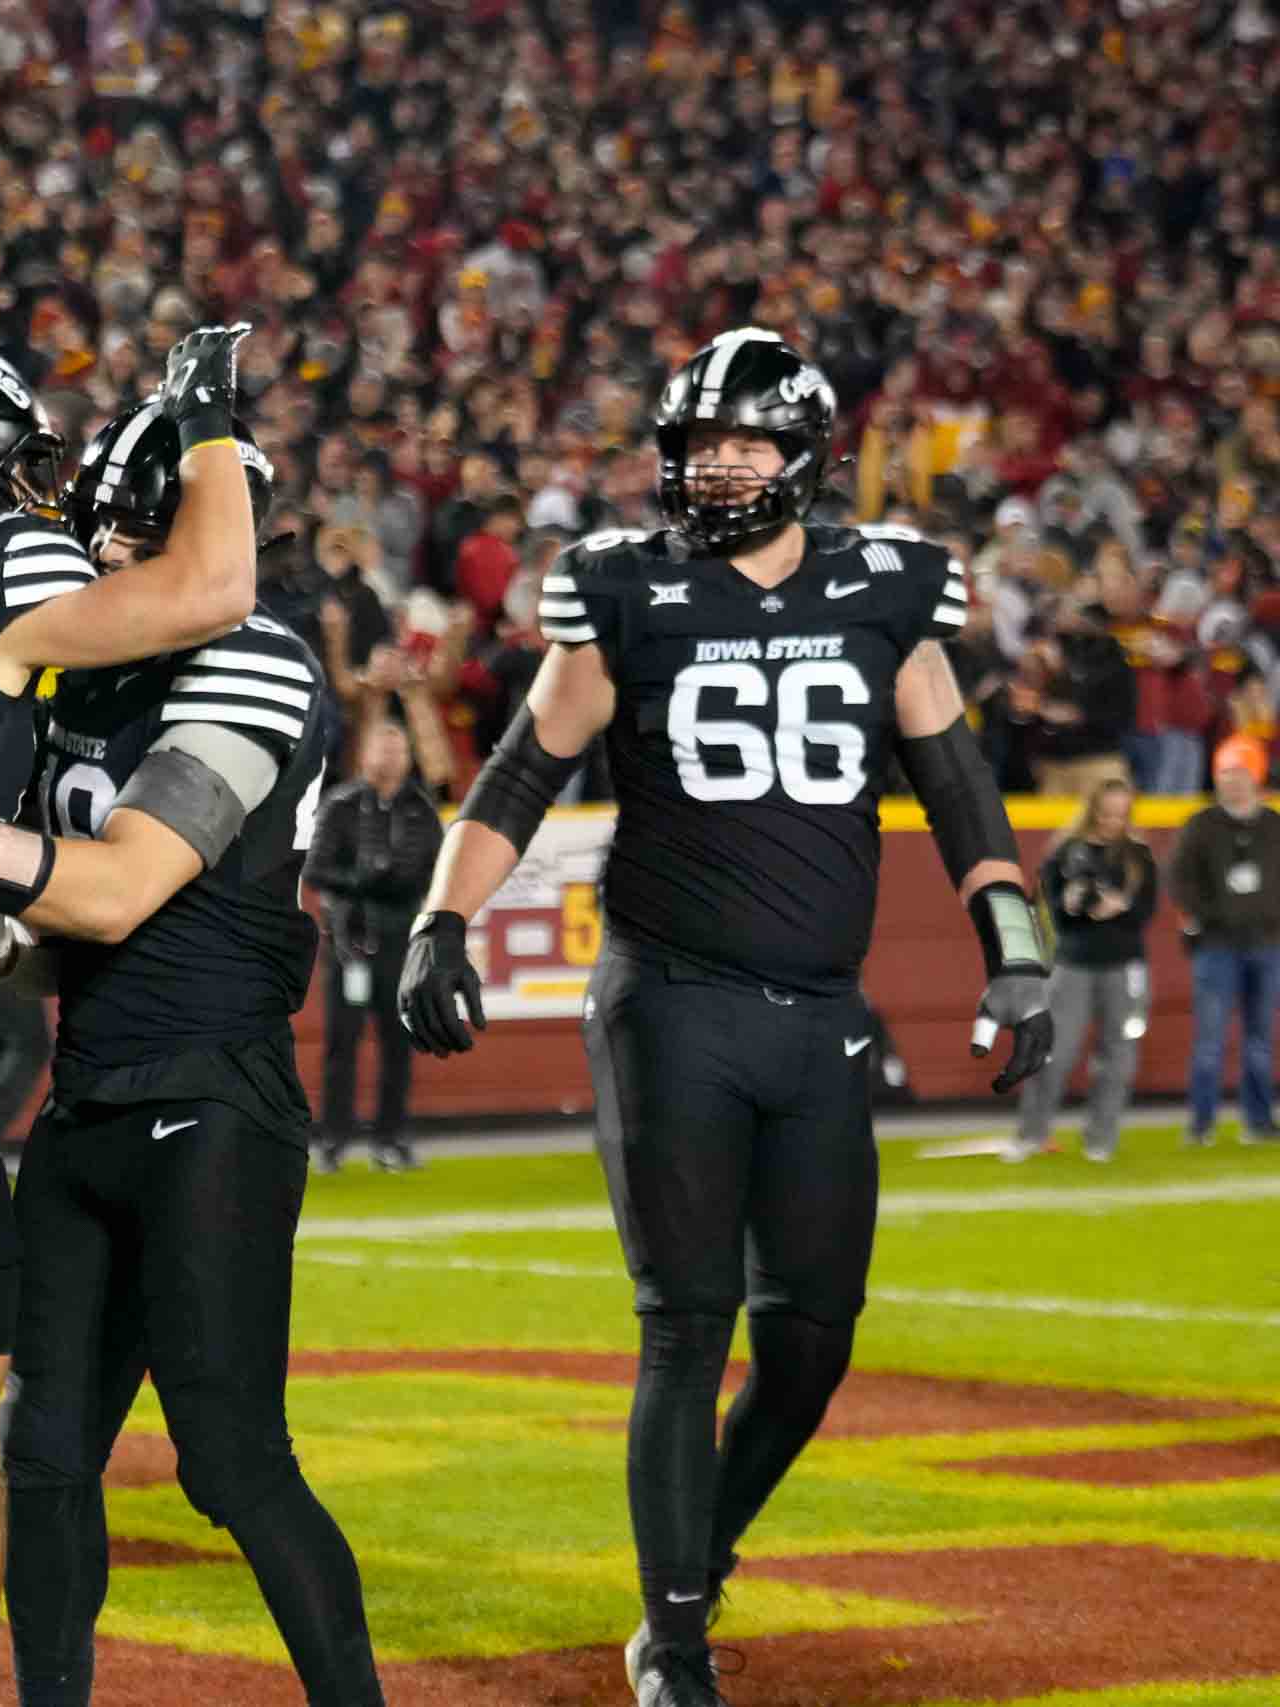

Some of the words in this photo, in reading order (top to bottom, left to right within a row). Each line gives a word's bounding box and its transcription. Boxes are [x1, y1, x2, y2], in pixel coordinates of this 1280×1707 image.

[695, 639, 761, 662] IOWA
[765, 637, 844, 660] STATE
[668, 661, 870, 804] 66
